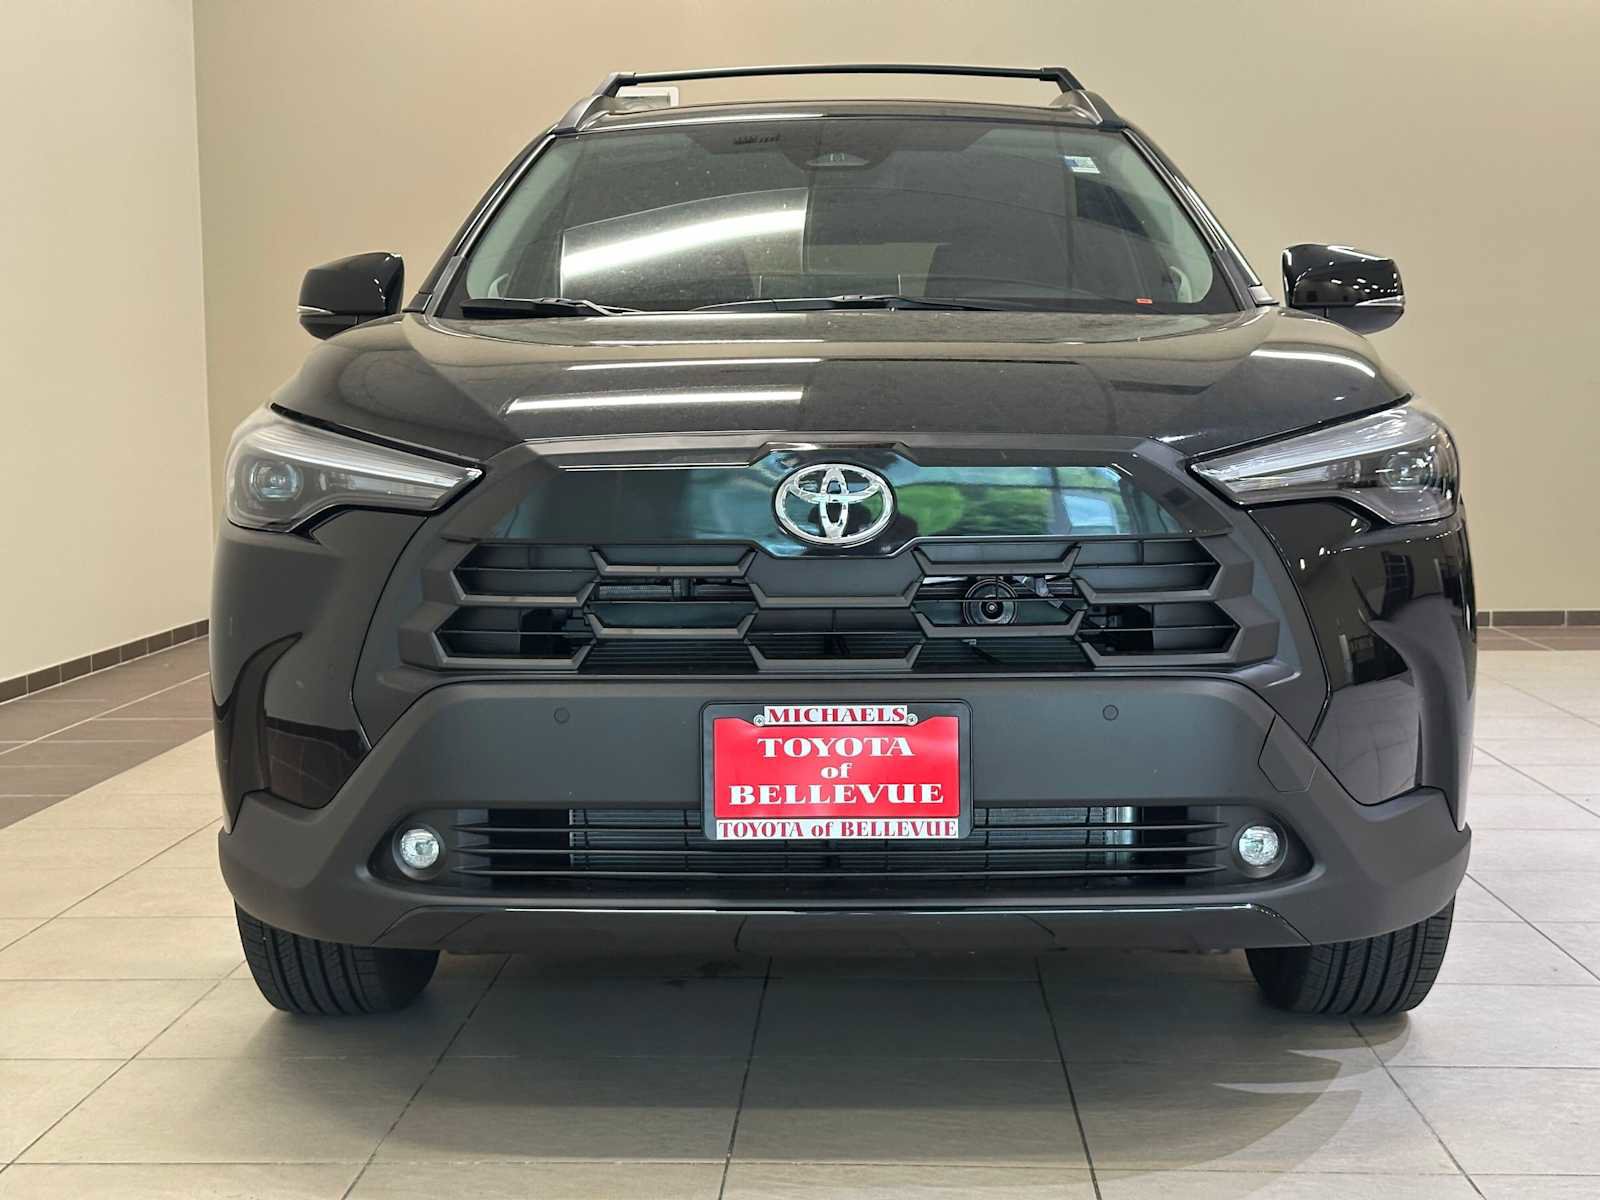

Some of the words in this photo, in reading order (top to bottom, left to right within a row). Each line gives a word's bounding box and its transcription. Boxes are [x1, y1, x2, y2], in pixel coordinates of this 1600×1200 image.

[768, 708, 905, 723] MICHAELS
[757, 737, 915, 757] TOYOTA
[820, 763, 852, 779] of
[728, 784, 944, 805] BELLEVUE
[718, 822, 804, 838] TOYOTA
[811, 821, 833, 837] of
[840, 820, 958, 837] BELLEVUE
